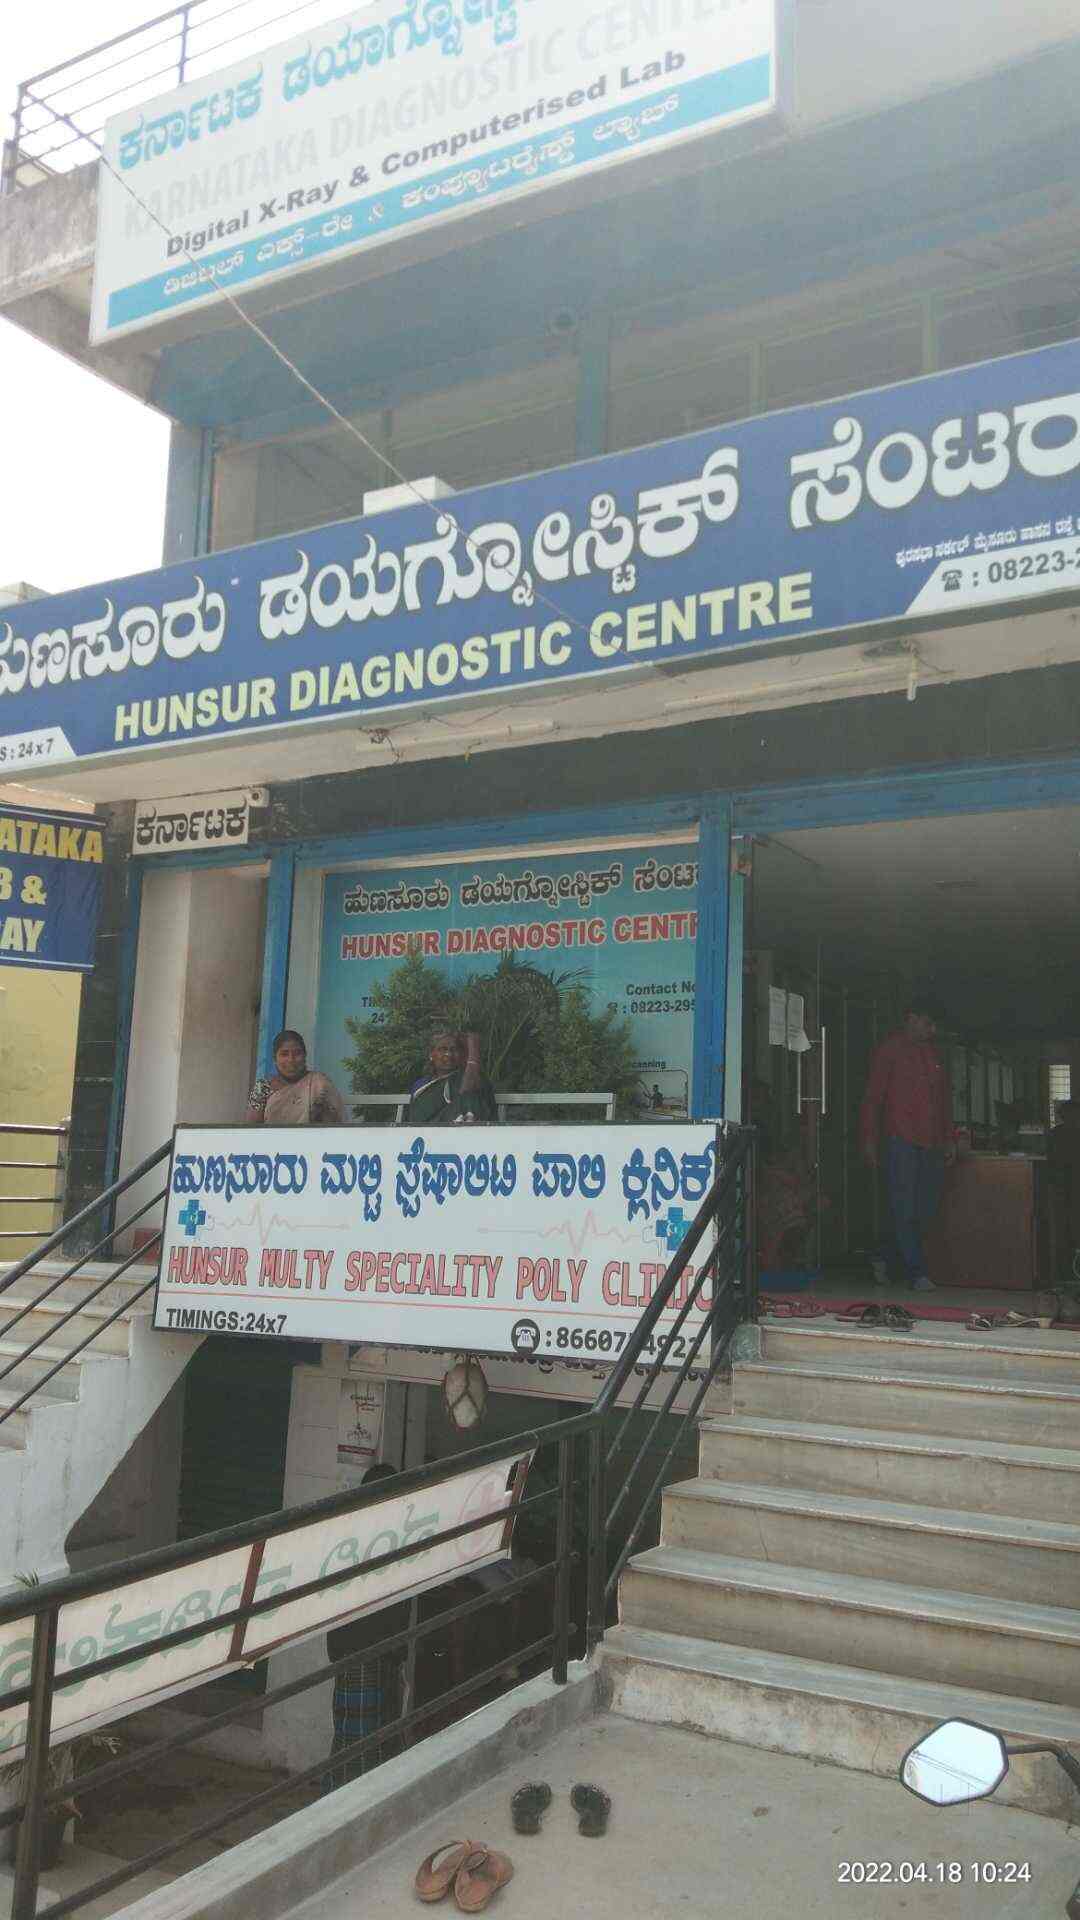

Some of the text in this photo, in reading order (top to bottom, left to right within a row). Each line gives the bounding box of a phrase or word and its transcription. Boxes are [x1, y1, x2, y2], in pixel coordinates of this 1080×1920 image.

[119, 62, 263, 170] ಕರ್ನಾಟಕ
[166, 51, 686, 257] Digital X-Ray & Computerised Lab
[114, 572, 813, 741] HUNSUR DIAGNOSTIC CENTRE
[136, 795, 247, 846] ಕರ್ನಾಟಕ
[21, 875, 47, 906] &
[344, 880, 450, 915] ಹುಣಸೂರು
[342, 930, 440, 960] HUNSUR
[447, 917, 606, 955] DIAGNOSTIC
[626, 982, 678, 996] Contact
[173, 1153, 308, 1203] ಹುಣಸೂರು
[320, 1153, 382, 1222] ಮಲ್ಟಿ
[532, 1151, 606, 1198] ಪಾಲಿ
[167, 1246, 248, 1286] HUNSUR
[259, 1248, 334, 1290] MULTY
[344, 1250, 503, 1298] SPECIALITY
[516, 1257, 587, 1303] POLY
